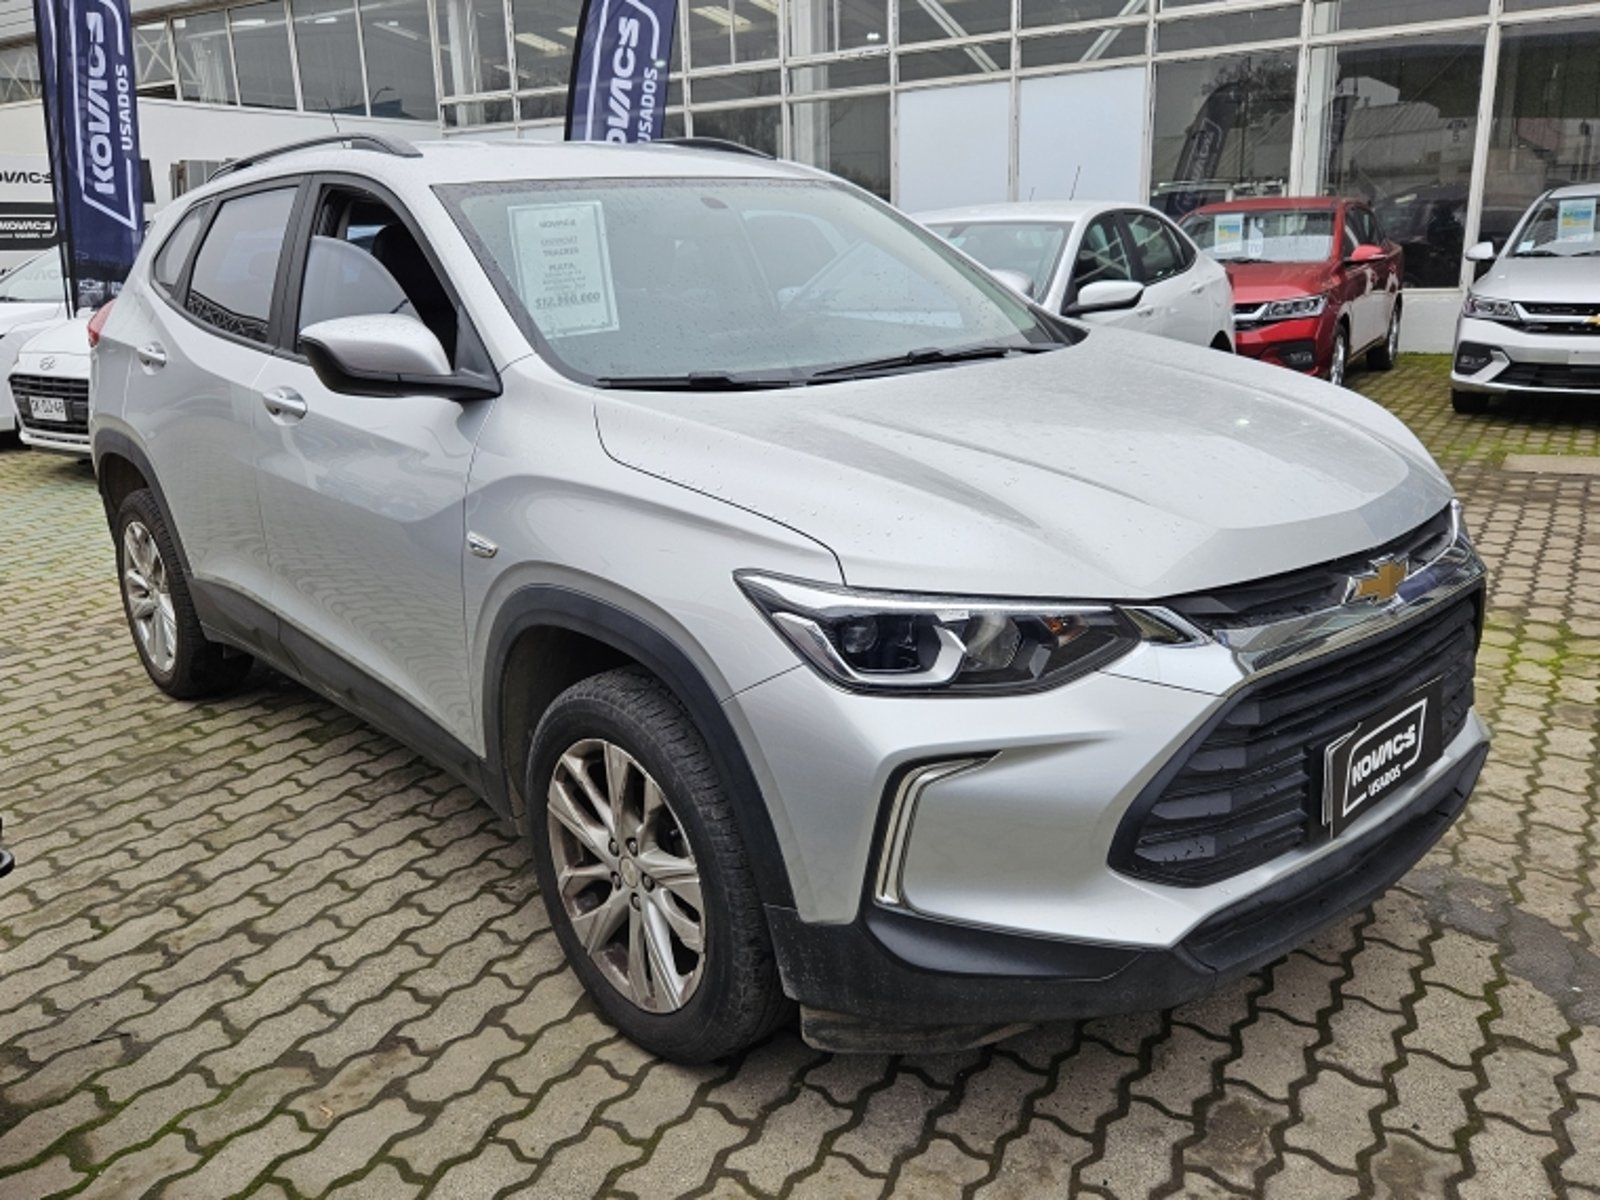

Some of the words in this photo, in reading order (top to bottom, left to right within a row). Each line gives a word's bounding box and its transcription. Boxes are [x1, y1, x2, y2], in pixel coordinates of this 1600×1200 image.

[86, 12, 116, 194] KOVACS
[115, 64, 133, 150] USADOS
[606, 17, 640, 143] OVACS
[0, 171, 53, 184] VACS
[1352, 724, 1416, 786] KOVACS
[1368, 764, 1401, 796] USADOS
